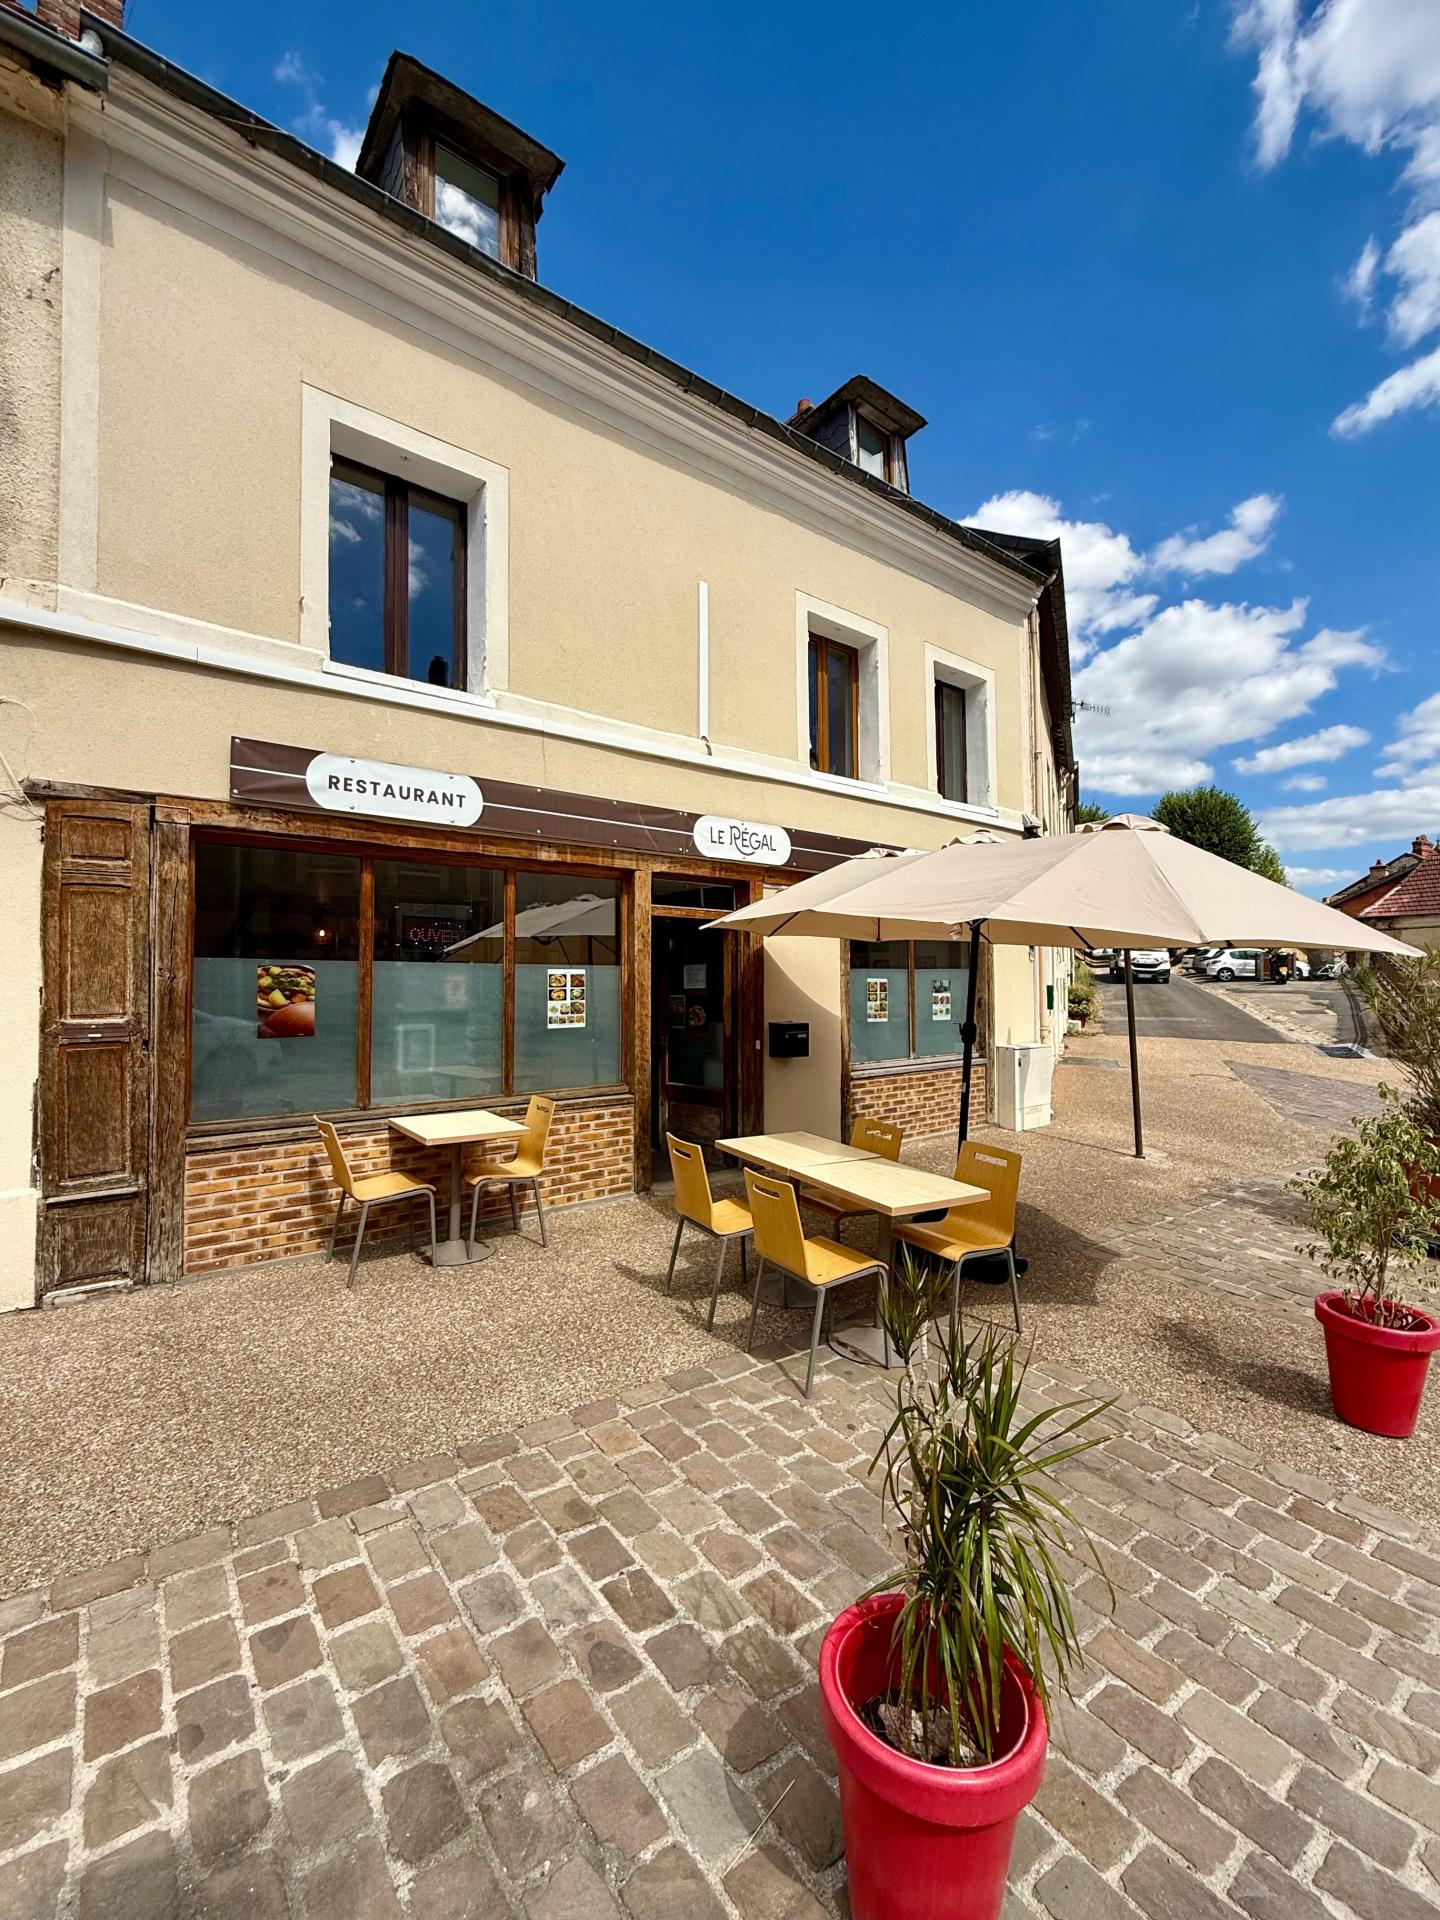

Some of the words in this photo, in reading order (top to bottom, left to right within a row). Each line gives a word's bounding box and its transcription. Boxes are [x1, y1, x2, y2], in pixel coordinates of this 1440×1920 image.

[328, 774, 466, 808] RESTAURANT
[709, 826, 725, 845] LE
[729, 825, 777, 856] RÉGAL
